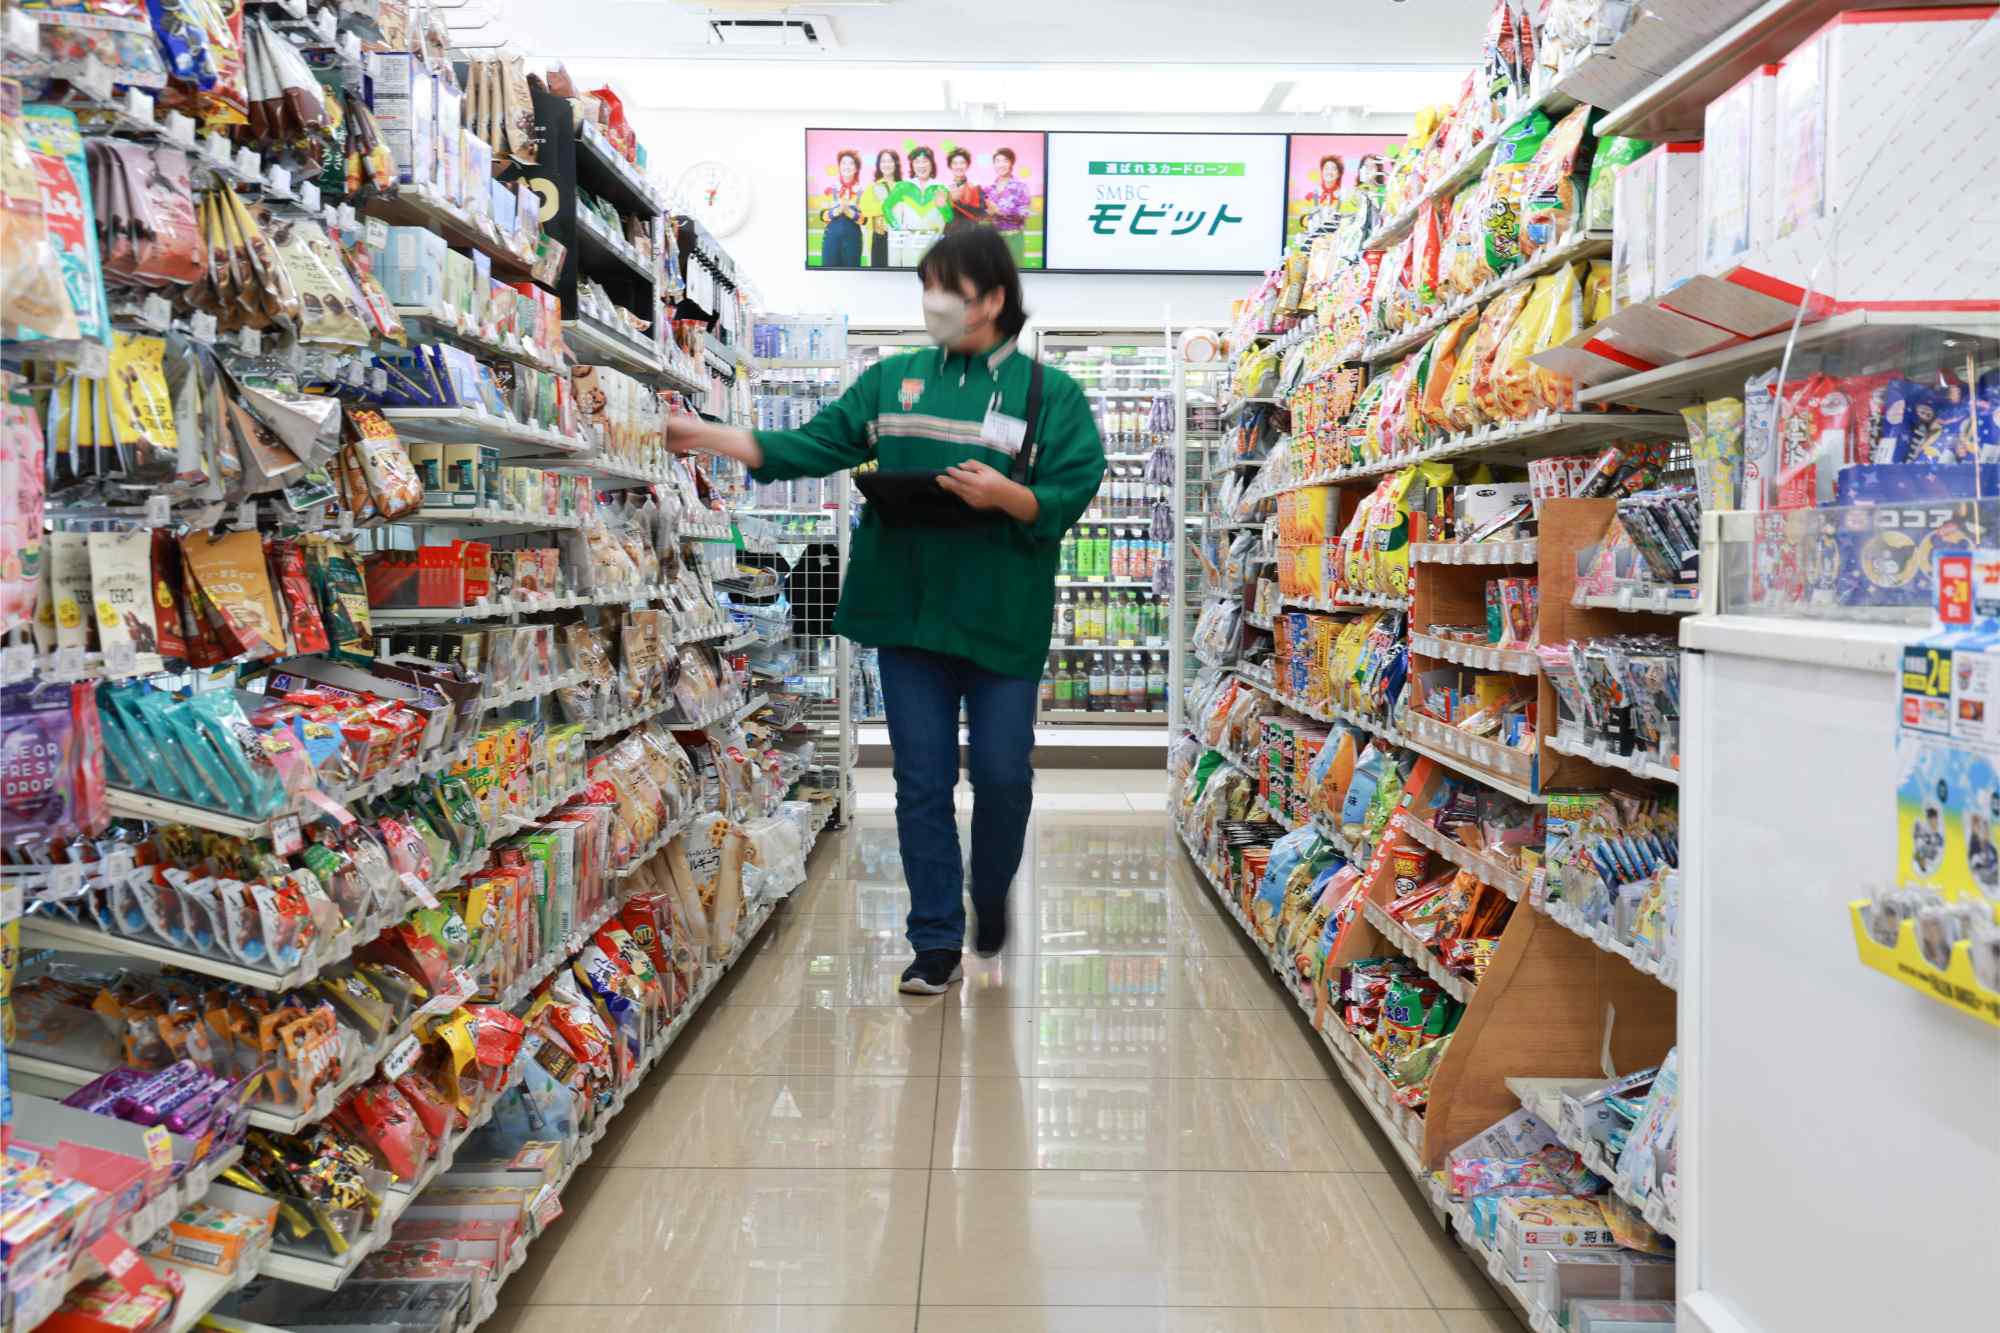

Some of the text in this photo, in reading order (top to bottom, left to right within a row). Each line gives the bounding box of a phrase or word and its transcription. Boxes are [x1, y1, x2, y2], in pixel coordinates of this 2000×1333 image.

[1106, 163, 1229, 175] 選ばれるカードローン
[1096, 184, 1150, 200] SMBC
[1088, 203, 1243, 236] モビット
